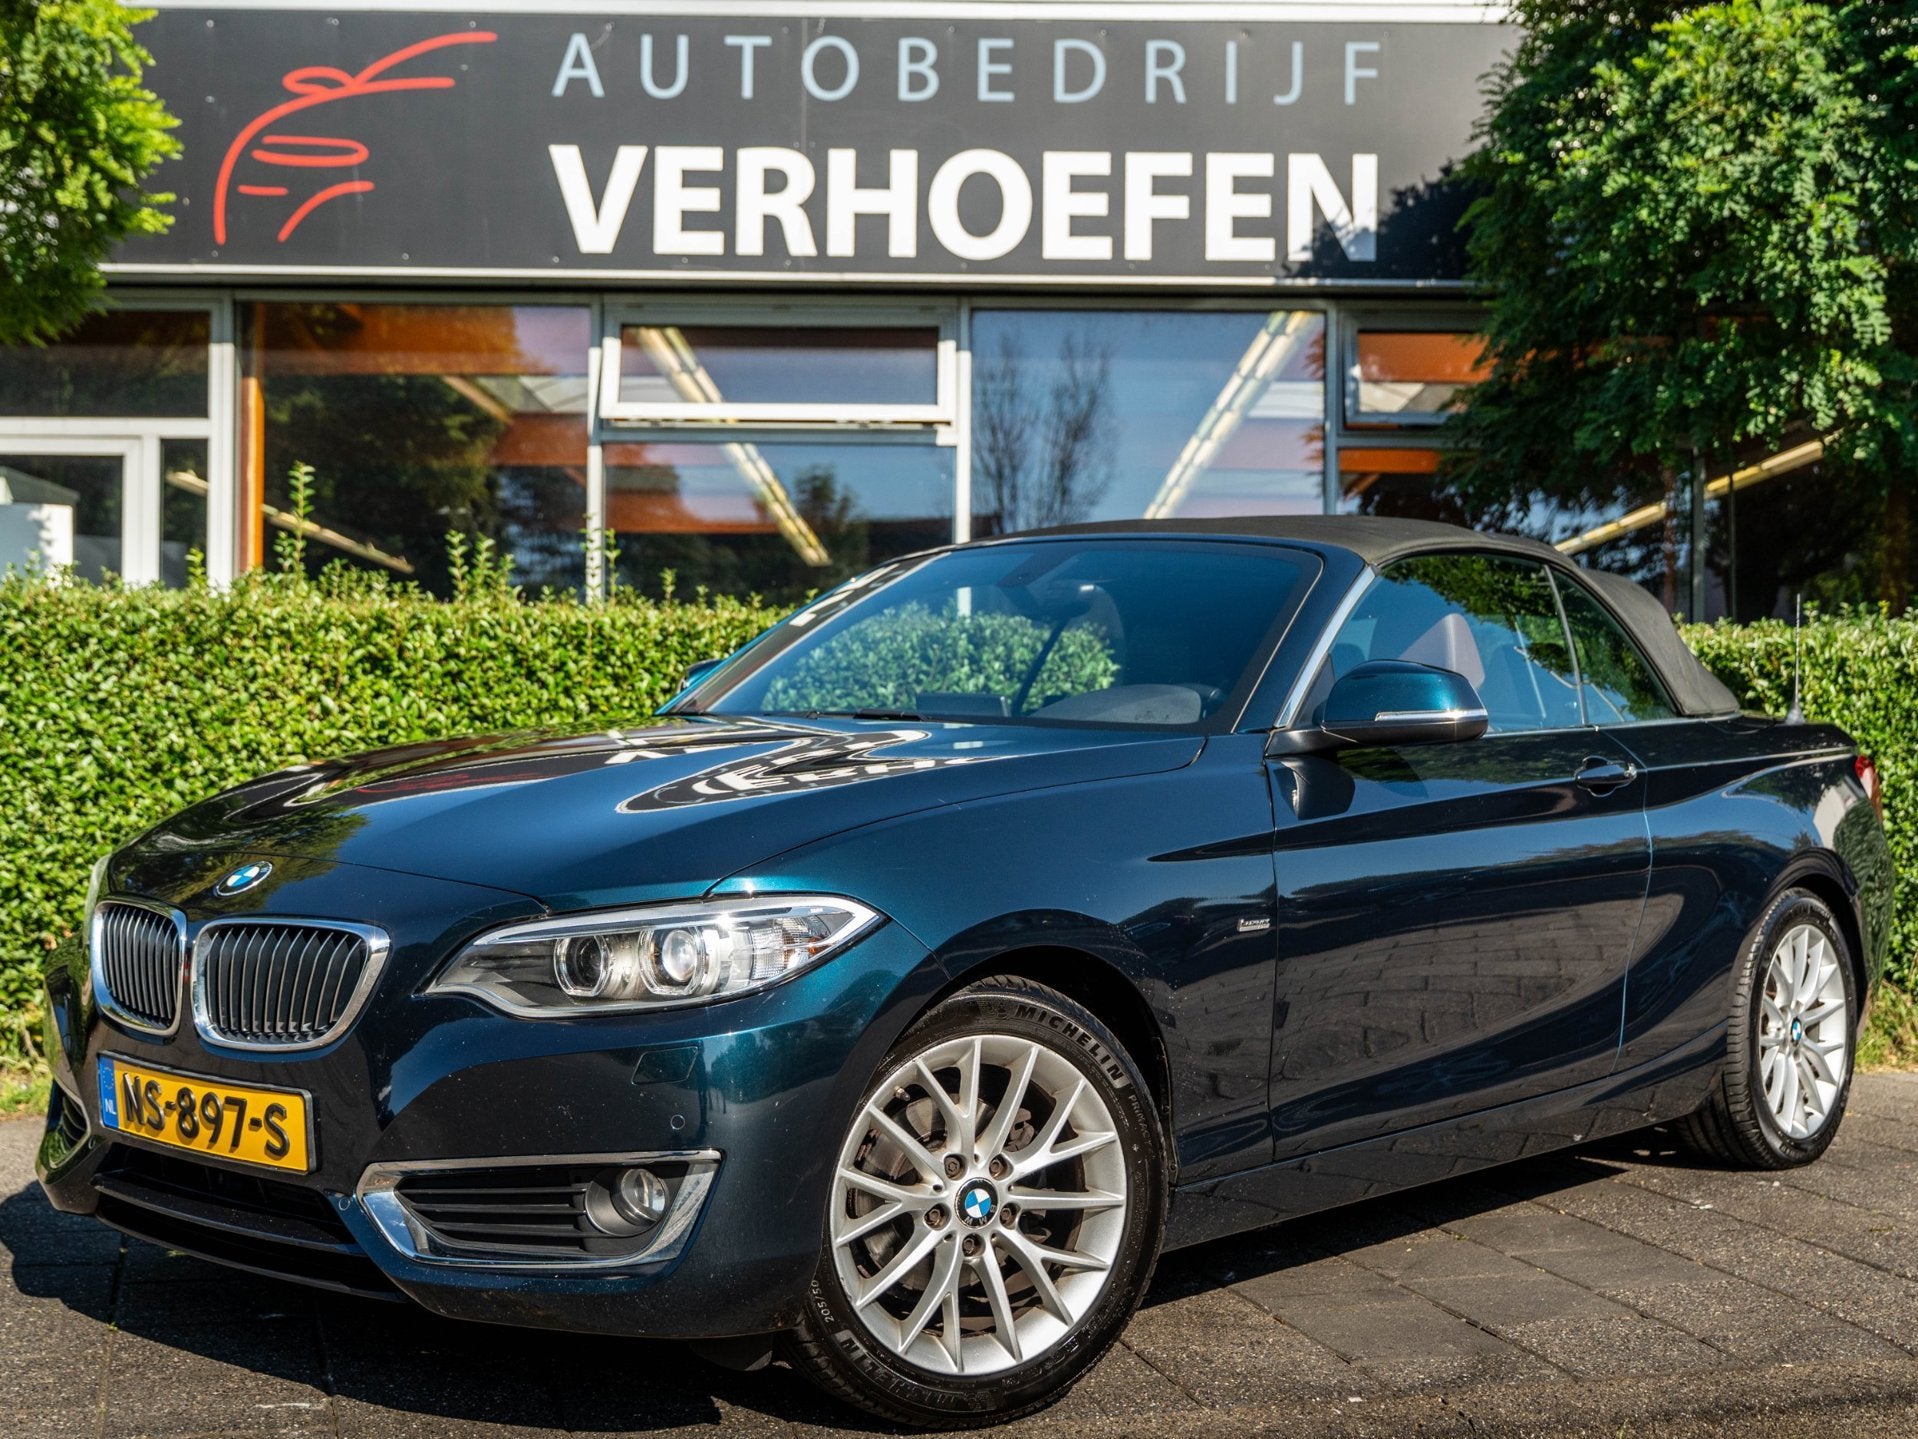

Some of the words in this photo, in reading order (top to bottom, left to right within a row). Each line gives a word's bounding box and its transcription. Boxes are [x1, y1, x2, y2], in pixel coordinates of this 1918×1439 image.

[551, 33, 1382, 105] AUTOBEDRIJF
[548, 144, 1379, 263] VERHOEFEN
[1015, 1004, 1124, 1081] MICHELIN
[104, 1098, 117, 1116] NL
[122, 1073, 290, 1158] NS-897-S
[811, 1279, 835, 1323] 205/50
